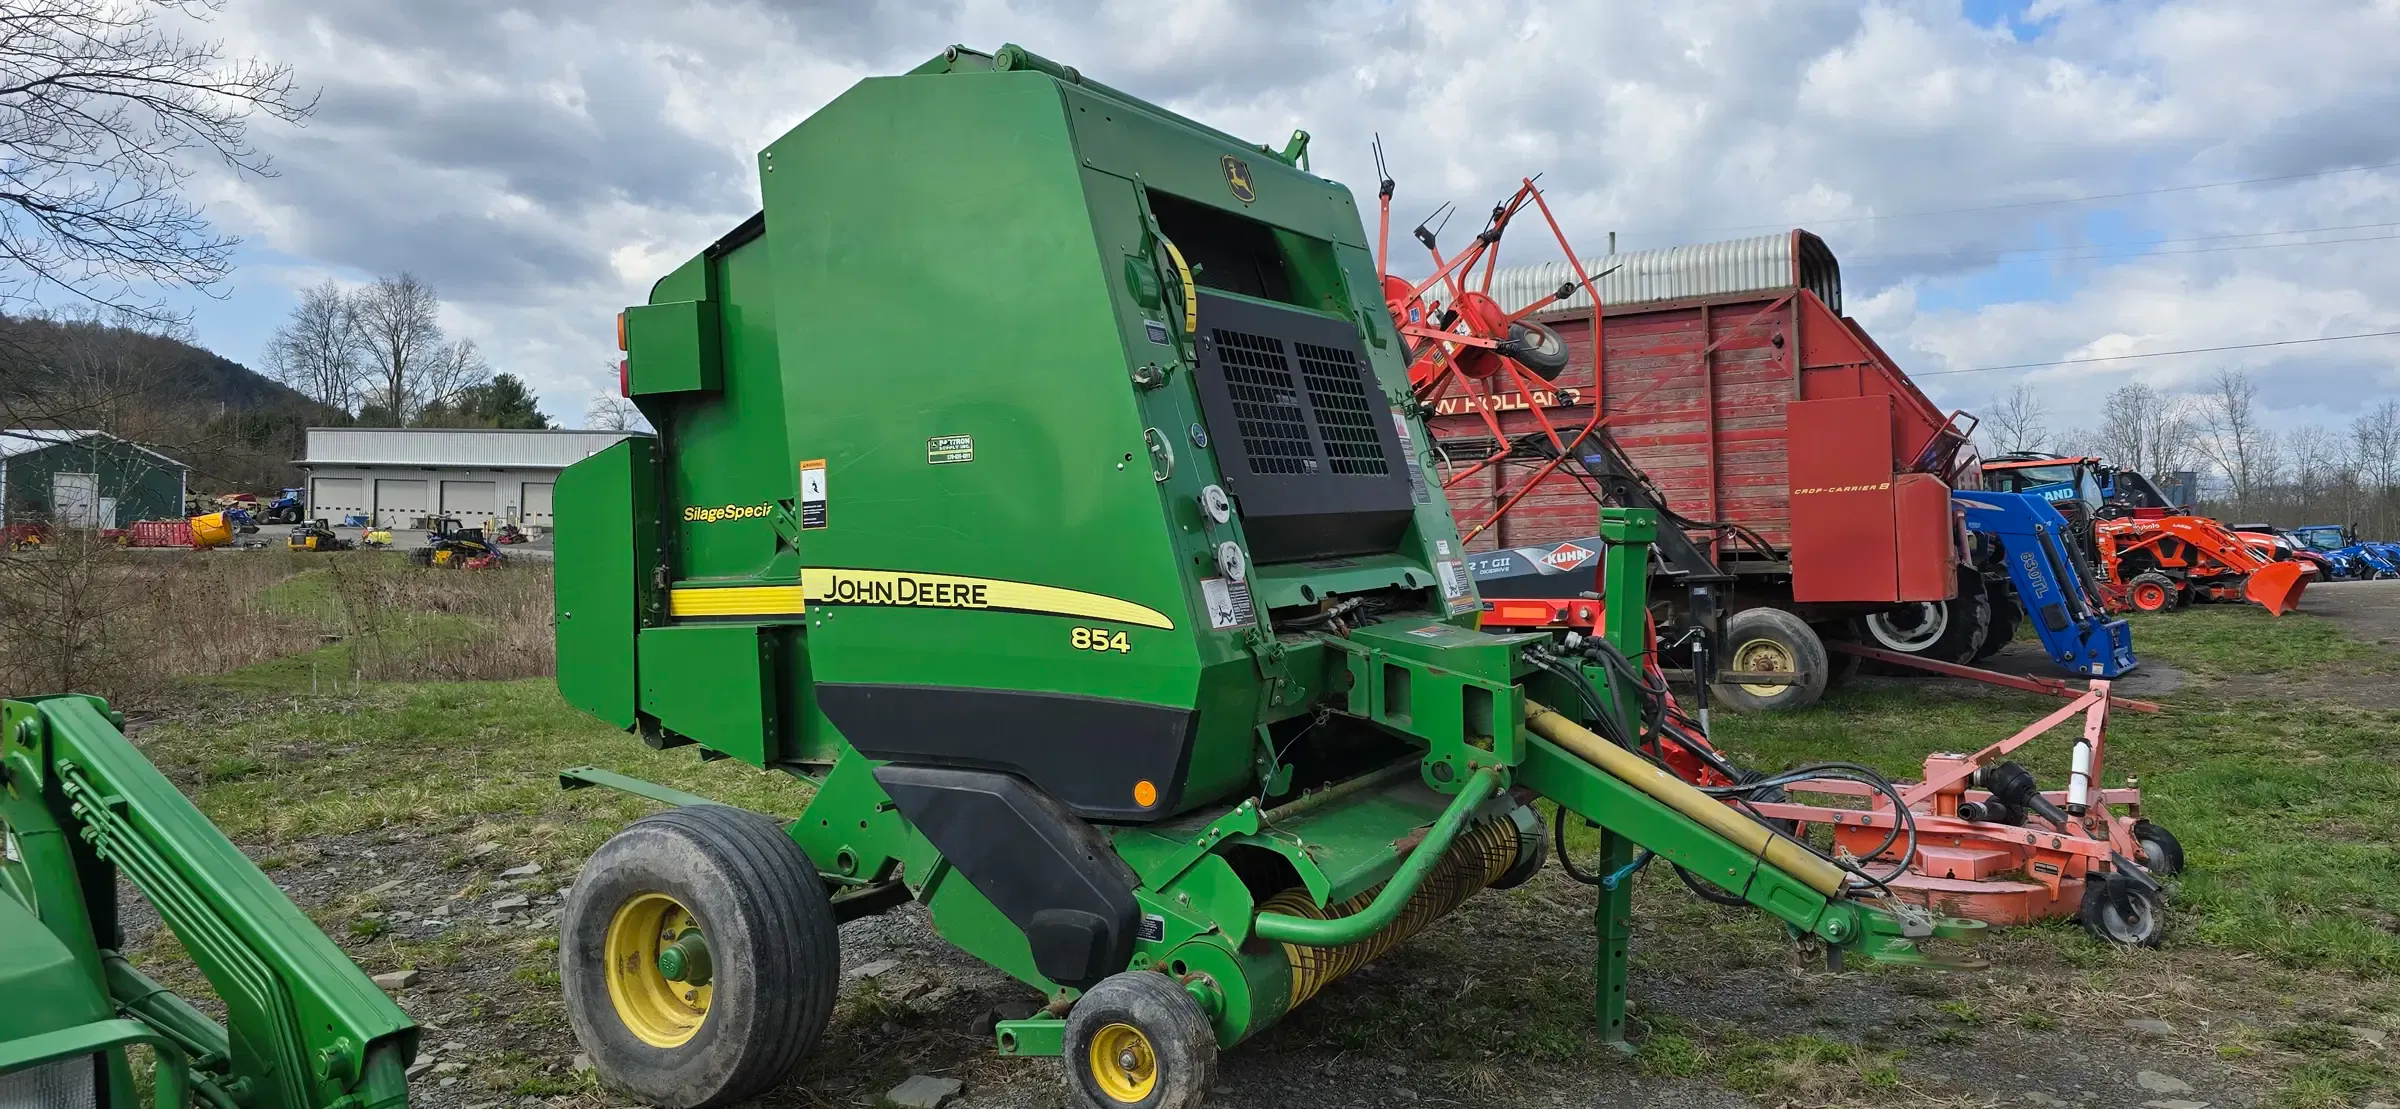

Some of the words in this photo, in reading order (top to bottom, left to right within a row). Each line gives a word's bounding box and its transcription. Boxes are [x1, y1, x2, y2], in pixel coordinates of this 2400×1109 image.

[1794, 484, 1877, 495] CROP-CARRIER
[2037, 487, 2074, 501] AND
[2135, 523, 2160, 531] ubota
[1547, 549, 1587, 566] KUHN
[2020, 551, 2049, 599] 830TL
[823, 575, 892, 601] JOHN
[898, 577, 988, 605] DEERE
[1070, 626, 1132, 654] 854
